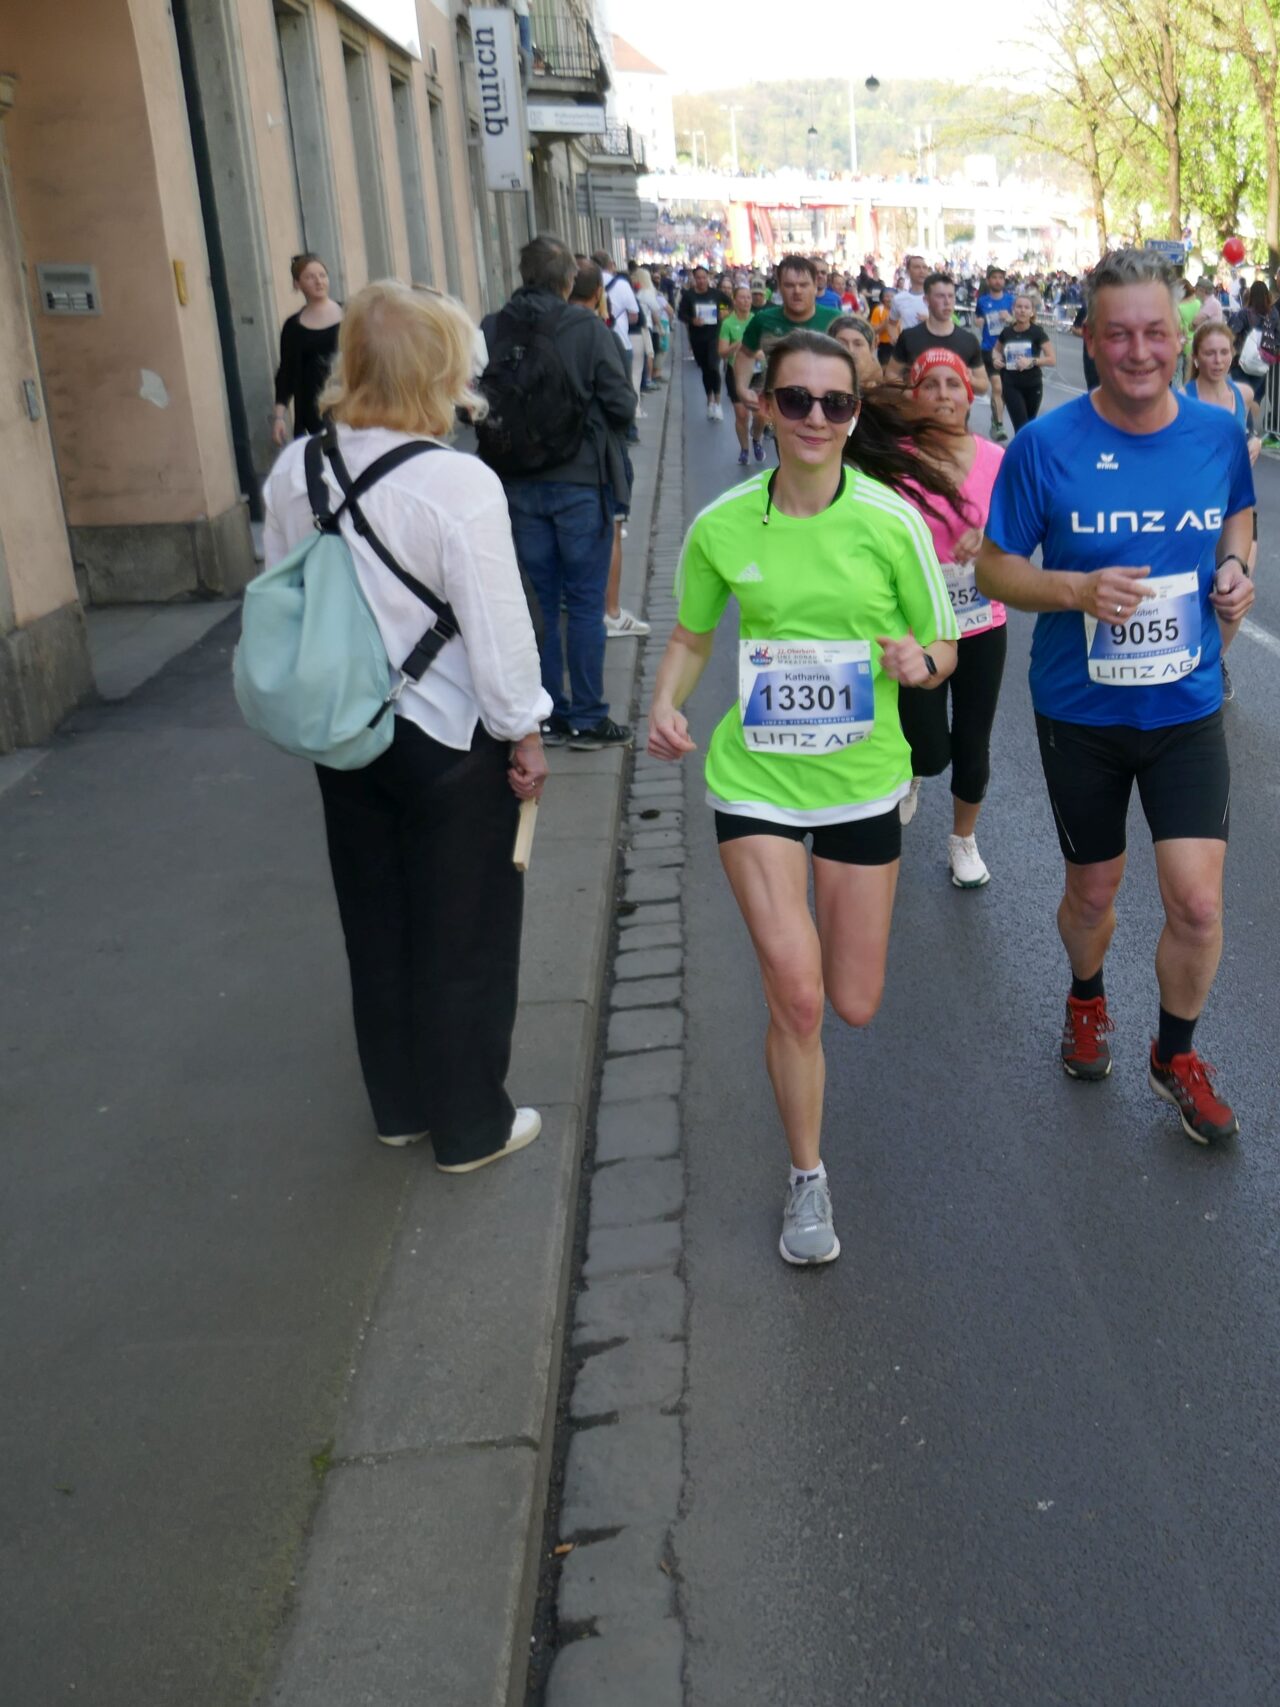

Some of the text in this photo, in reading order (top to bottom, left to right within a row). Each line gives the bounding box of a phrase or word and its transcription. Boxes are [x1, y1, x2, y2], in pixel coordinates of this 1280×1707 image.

[475, 27, 509, 136] quitch
[1175, 508, 1222, 531] AG
[965, 613, 988, 627] AG
[1110, 618, 1179, 645] 9055
[785, 672, 831, 681] Katharina
[1162, 659, 1193, 677] AG
[760, 684, 852, 711] 13301
